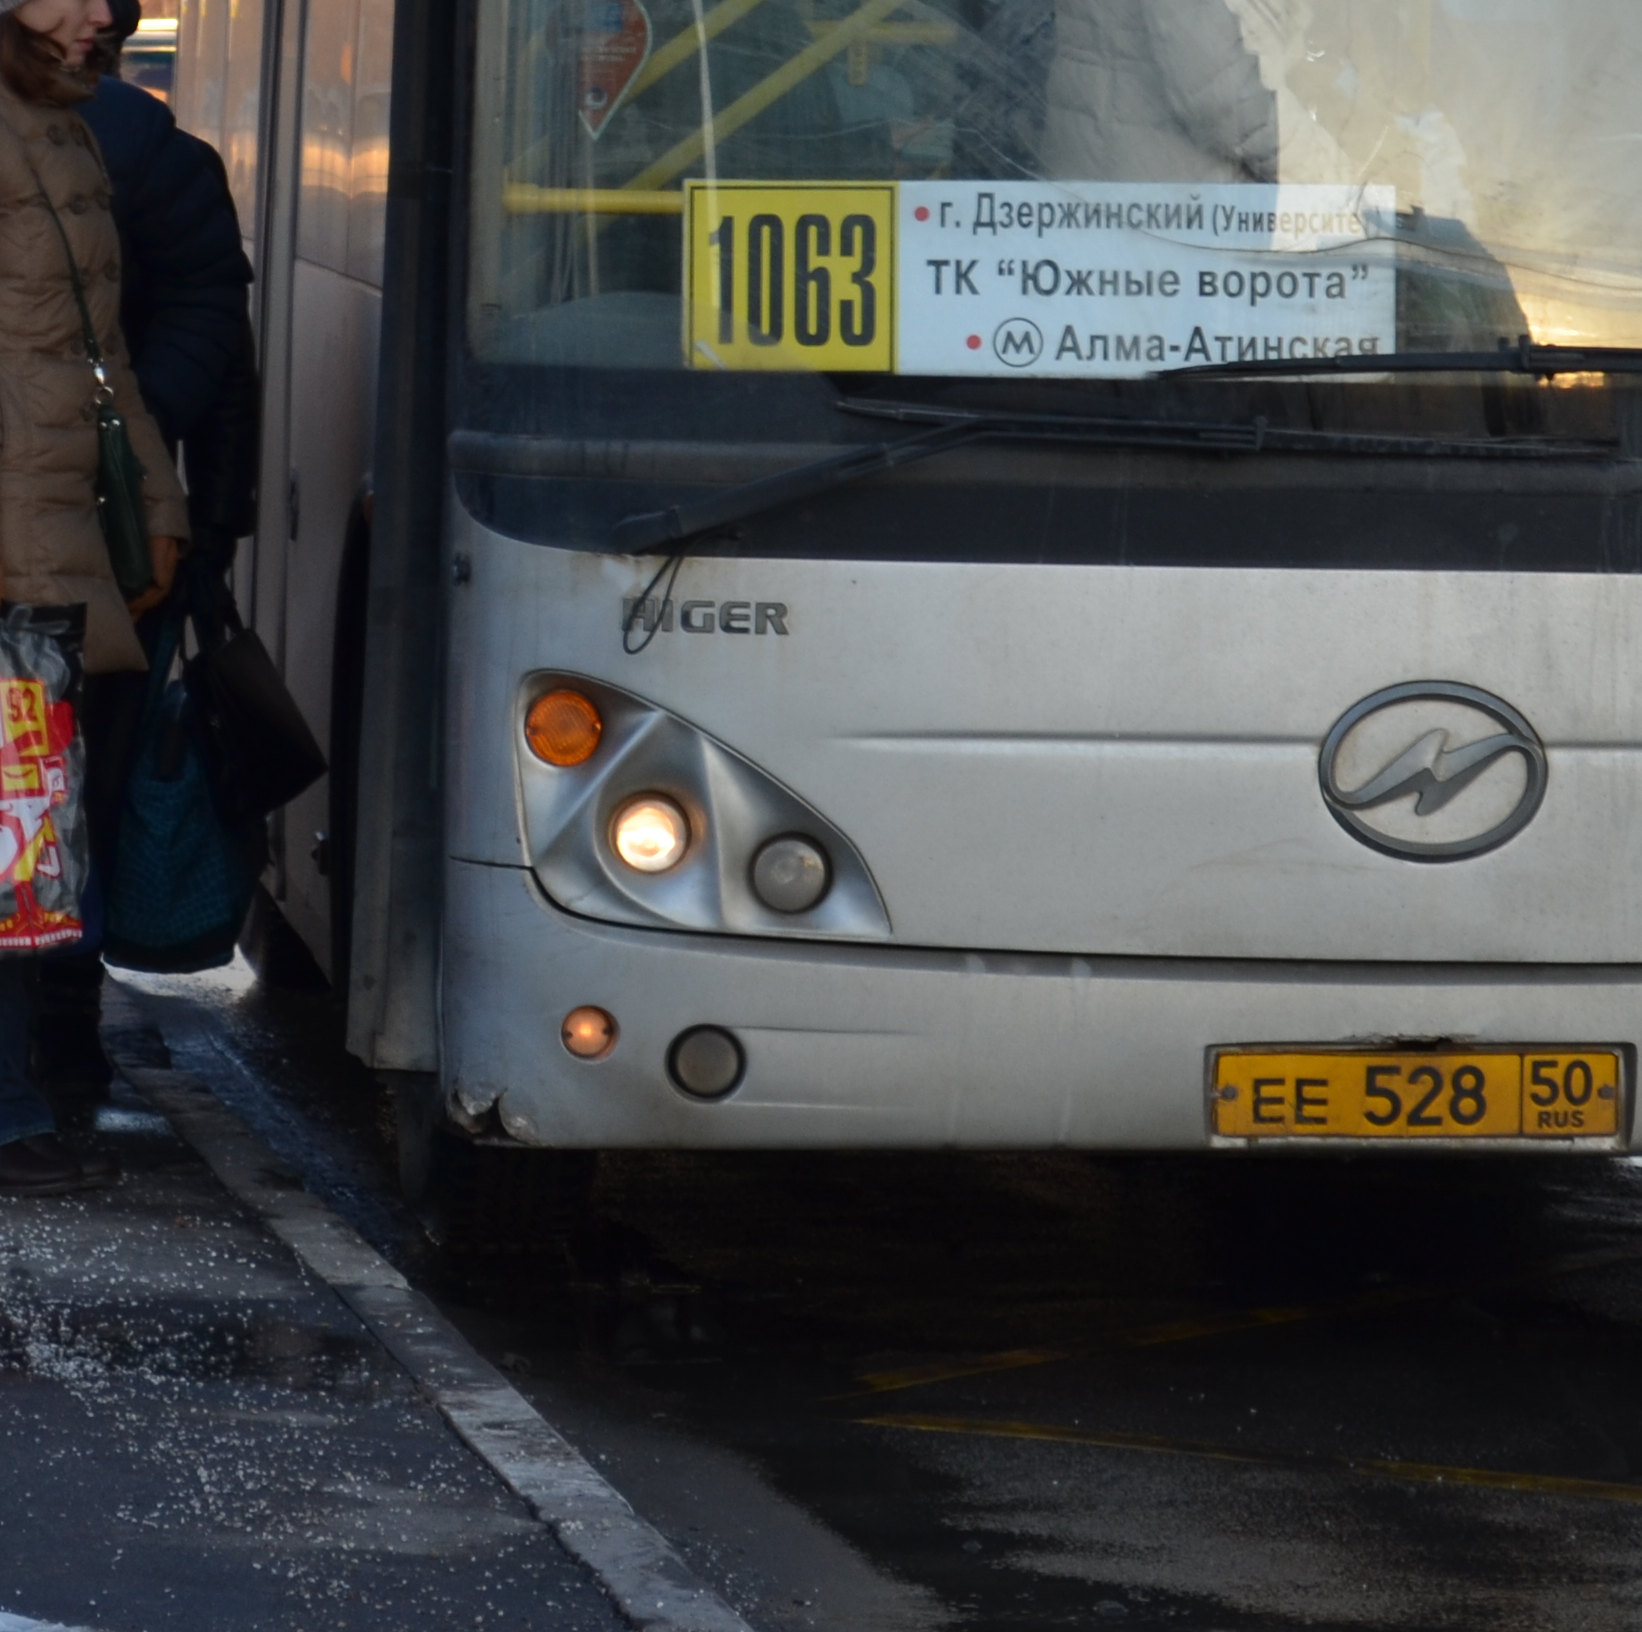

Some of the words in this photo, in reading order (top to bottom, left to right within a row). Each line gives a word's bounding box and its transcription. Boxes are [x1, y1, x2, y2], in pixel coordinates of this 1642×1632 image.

[940, 202, 961, 228] г.
[973, 192, 1204, 238] Дзержинский
[709, 213, 876, 347] 1063
[926, 259, 980, 295] ТК
[1055, 325, 1379, 363] Алма-Атинская
[622, 598, 789, 635] HIGER
[1363, 1065, 1487, 1127] 528
[1529, 1059, 1593, 1106] 50
[1537, 1110, 1585, 1128] RUS
